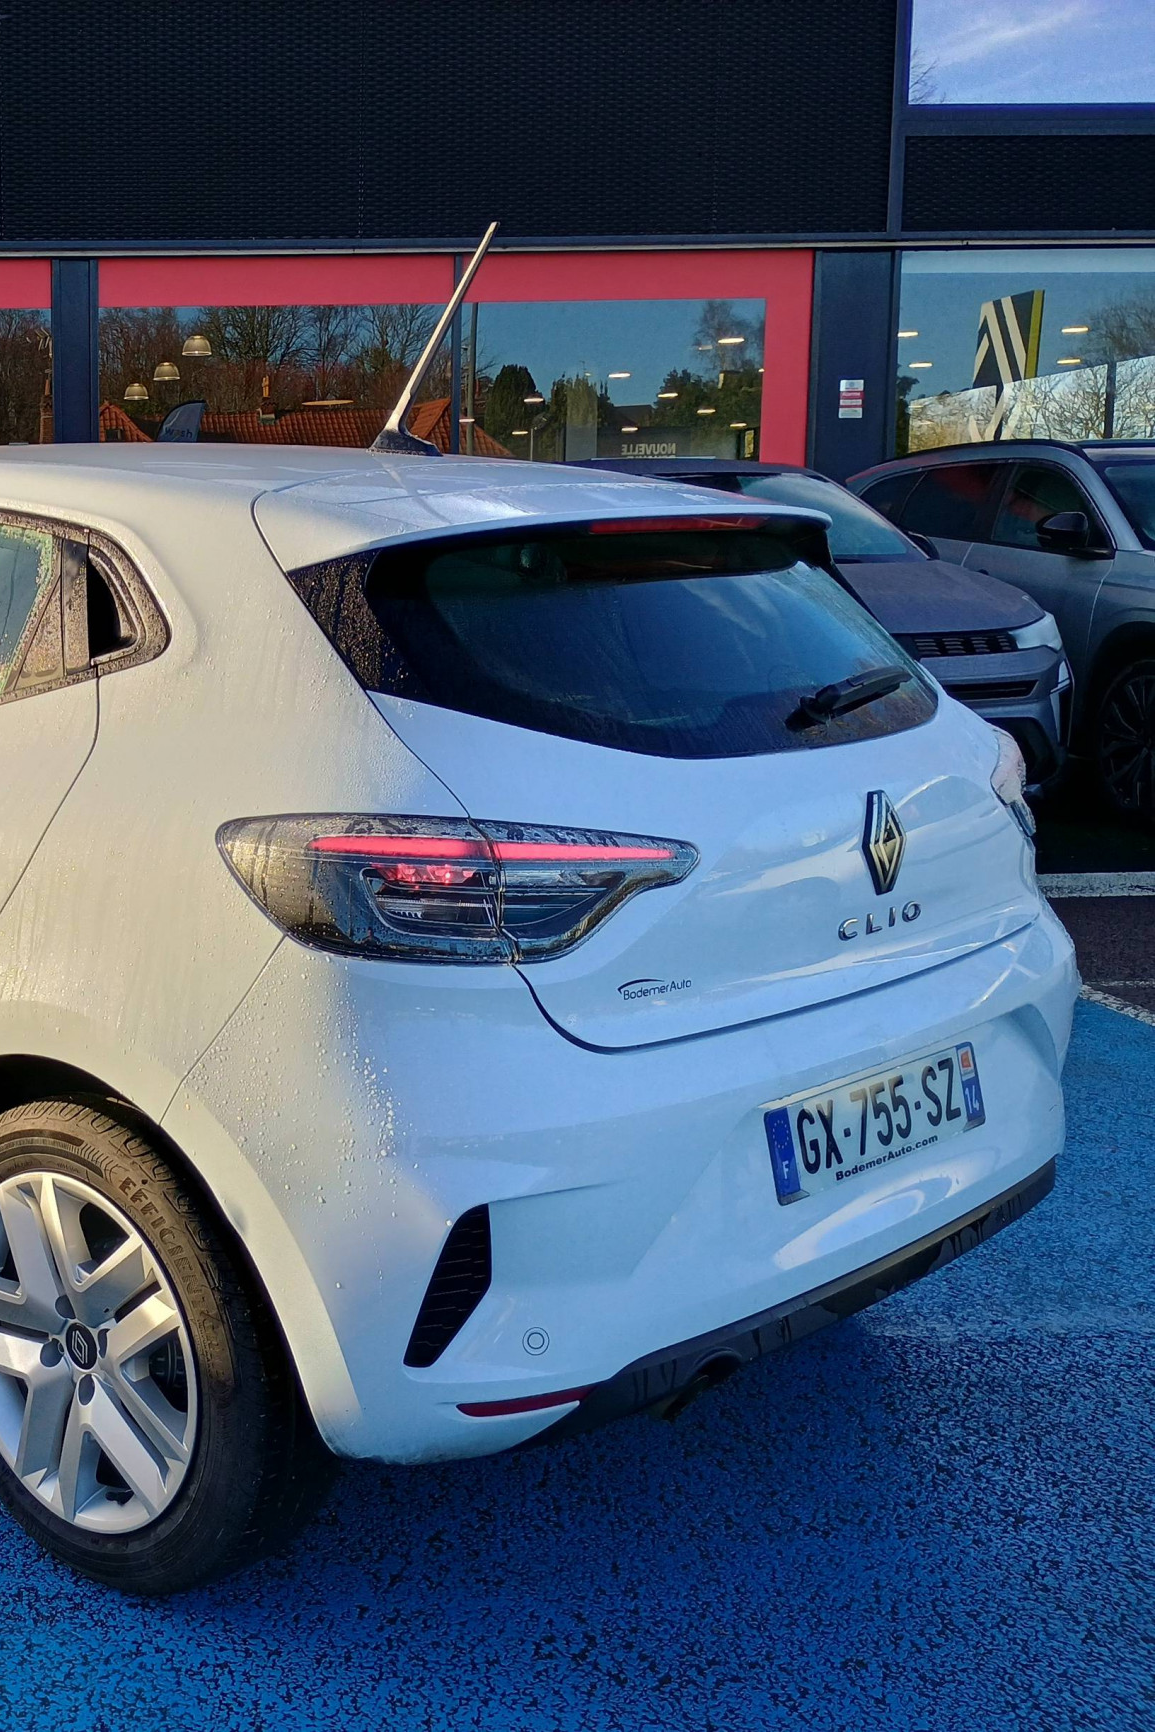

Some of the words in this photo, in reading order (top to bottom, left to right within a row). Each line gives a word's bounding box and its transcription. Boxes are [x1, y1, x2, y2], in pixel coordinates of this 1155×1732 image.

[838, 901, 921, 941] CLIO
[623, 979, 692, 1001] BodemerAuto
[964, 1084, 980, 1116] 14
[782, 1160, 789, 1180] F
[835, 1134, 939, 1181] BodemerAuto.com
